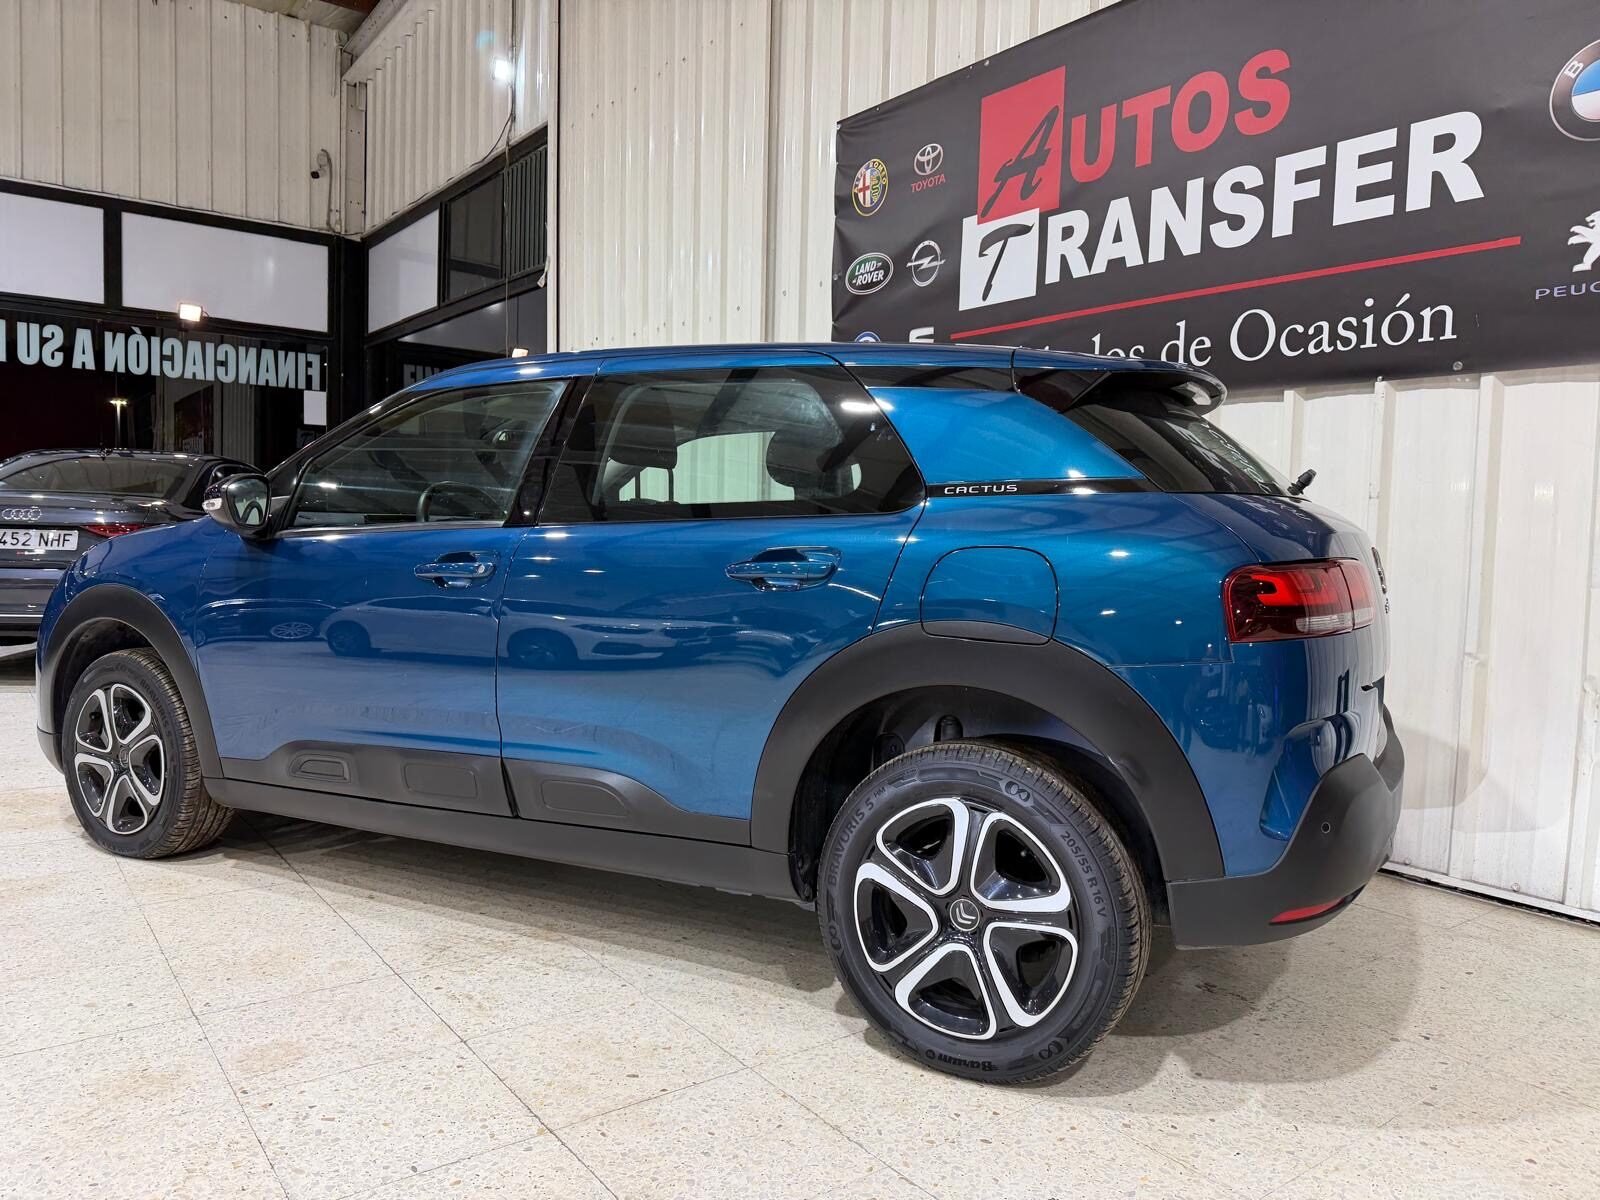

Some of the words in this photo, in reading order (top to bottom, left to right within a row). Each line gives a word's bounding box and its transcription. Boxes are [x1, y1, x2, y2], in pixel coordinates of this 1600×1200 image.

[979, 48, 1291, 219] AUTOS
[910, 173, 946, 193] TOYOTA
[977, 111, 1485, 302] TRANSFER
[855, 260, 878, 276] LAND
[856, 269, 885, 287] ROVER
[1160, 319, 1212, 368] de
[1229, 292, 1457, 362] Ocasión
[944, 484, 1018, 495] CACTUS
[38, 532, 73, 548] NHF
[828, 808, 866, 887] BRAVURIS
[1060, 830, 1093, 874] 205/55
[1087, 876, 1098, 888] R
